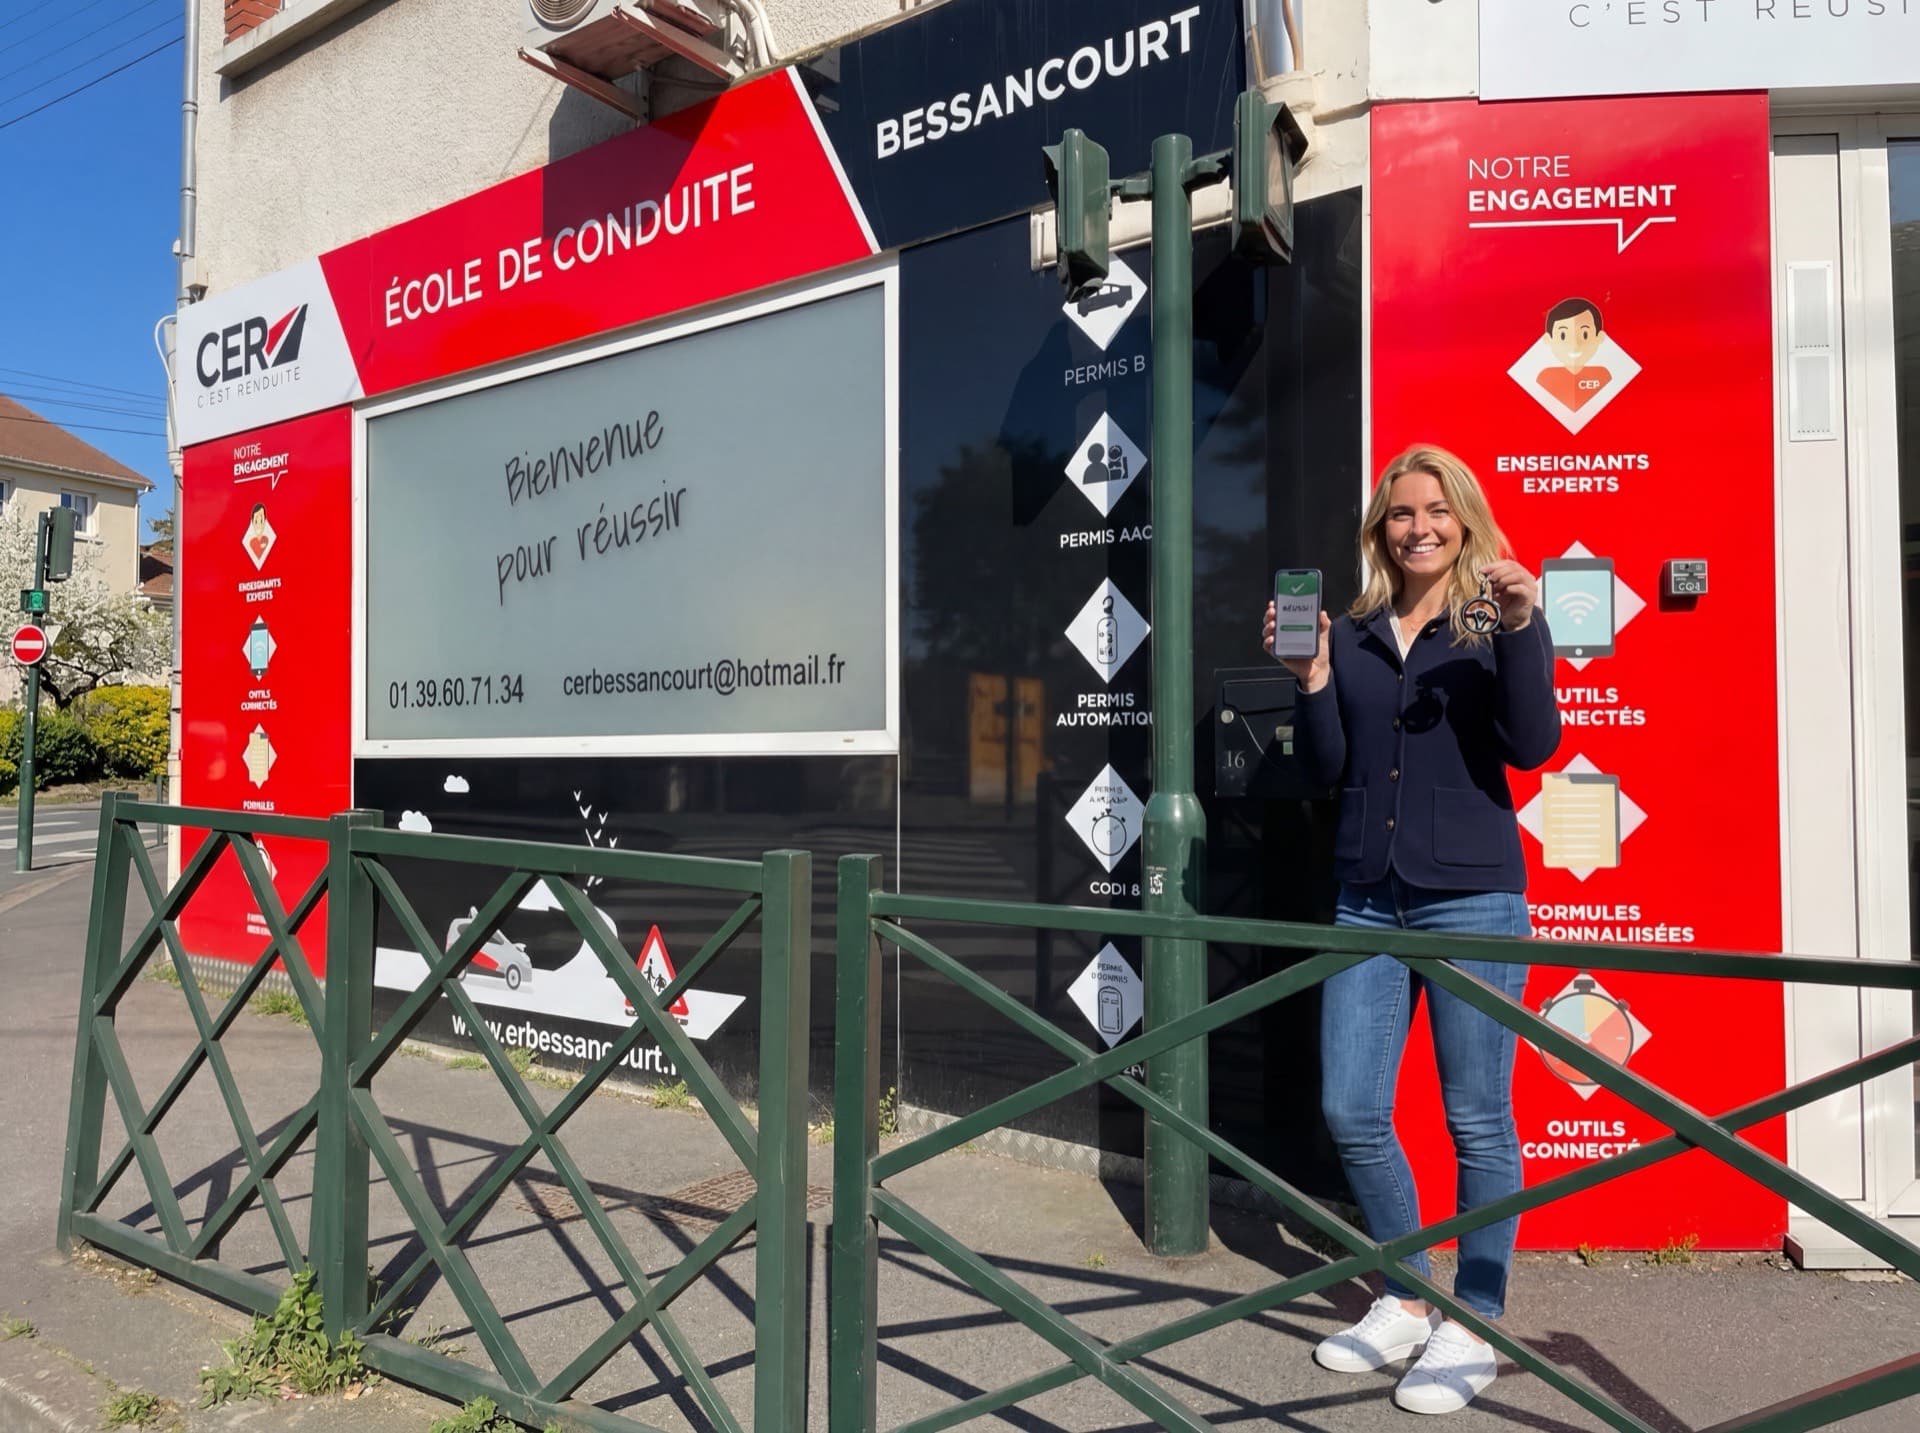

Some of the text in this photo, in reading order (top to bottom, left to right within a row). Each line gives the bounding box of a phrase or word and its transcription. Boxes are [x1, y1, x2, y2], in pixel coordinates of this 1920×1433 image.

[1569, 0, 1716, 28] C'EST
[876, 5, 1201, 160] BESSANCOURT
[1468, 155, 1571, 181] NOTRE
[1468, 184, 1677, 212] ENGAGEMENT
[385, 162, 755, 328] ÉCOLE DE CONDUITE
[196, 315, 269, 388] CER
[237, 366, 301, 397] RENDUITE
[1064, 354, 1146, 387] PERMIS B
[233, 443, 261, 460] NOTRE
[505, 410, 664, 506] Bienvenue
[233, 453, 289, 476] ENGAGEMENT
[1496, 454, 1650, 473] ENSEIGNANTS
[1522, 476, 1620, 494] EXPERTS
[497, 479, 687, 607] pour réussir
[1060, 529, 1115, 549] PERMIS
[389, 653, 846, 710] 01.39.60.71.34 cerbessancourt@hotmail.fr
[1077, 693, 1135, 708] PERMIS
[1555, 687, 1619, 704] UTILS
[1056, 711, 1153, 727] AUTOMATIQ
[1560, 705, 1646, 726] NECTÉS
[1228, 750, 1246, 769] 16
[1089, 881, 1127, 897] CODI
[1528, 904, 1642, 921] FORMULES
[1546, 1119, 1627, 1137] OUTILS
